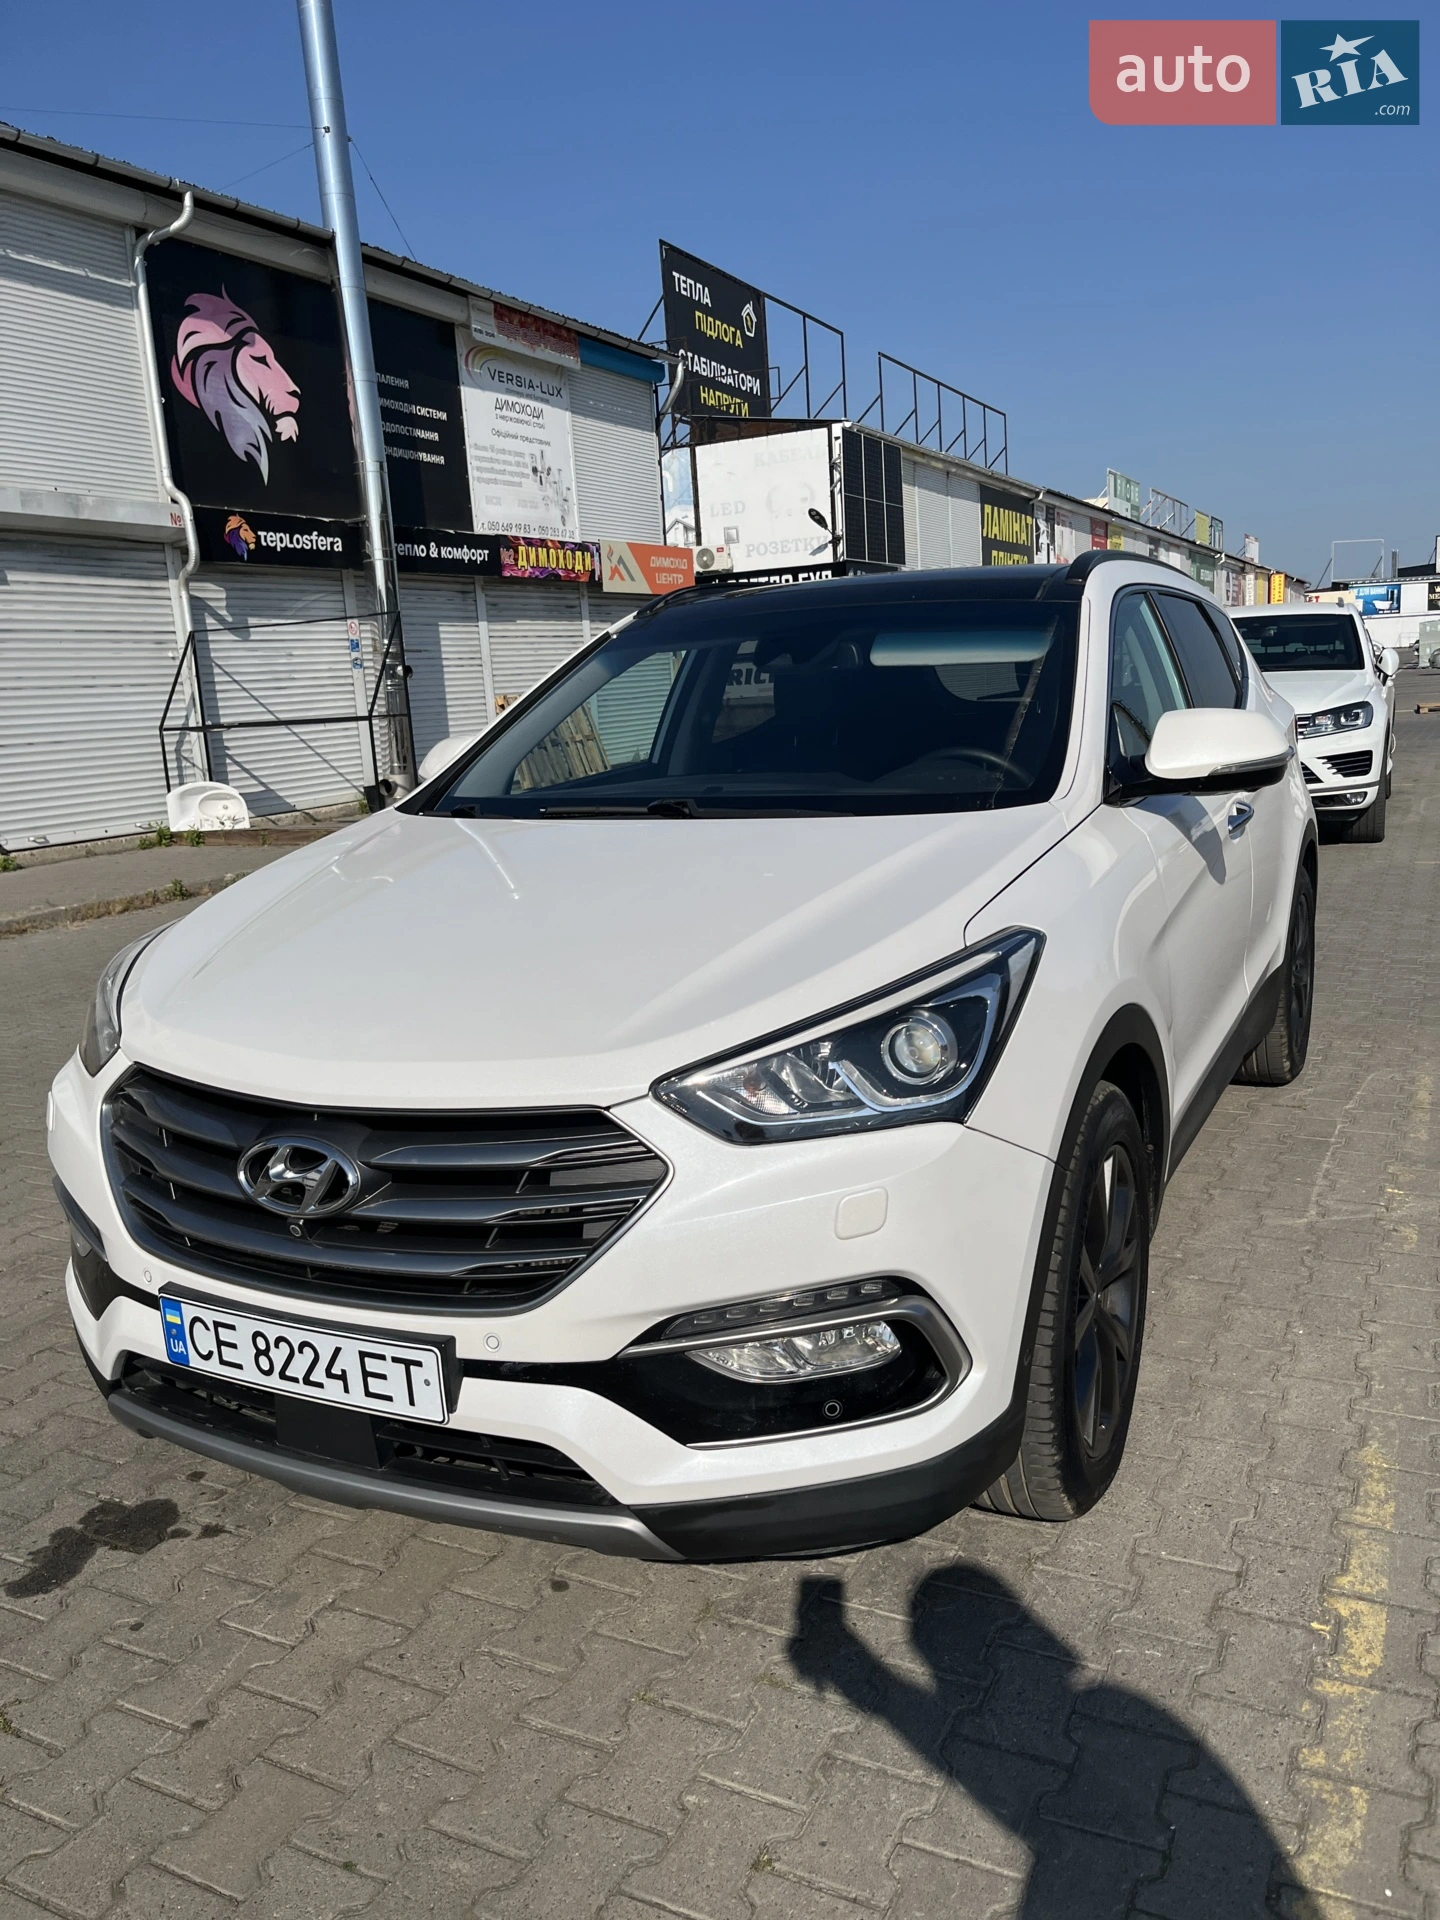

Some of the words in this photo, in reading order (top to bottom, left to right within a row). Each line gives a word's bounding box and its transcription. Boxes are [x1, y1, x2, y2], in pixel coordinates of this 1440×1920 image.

[672, 271, 712, 307] ТЕПЛА
[695, 311, 743, 348] ПІДЛОГА
[376, 372, 409, 389] ПАЛЕННЯ
[487, 366, 563, 398] VERSIA-LUX
[678, 349, 761, 396] СТАБІЛІЗАТОРИ
[379, 397, 416, 414] ИМОХОДНІ
[416, 406, 447, 421] СИСТЕМИ
[495, 397, 544, 420] ДИМОХОДИ
[700, 385, 749, 417] НАПРУГИ
[381, 421, 440, 441] ОДОПОСТАЧАННЯ
[384, 445, 445, 465] ОНДИЦІОНУВАННЯ
[711, 500, 745, 518] LED
[487, 521, 500, 532] 050
[501, 521, 513, 533] 649
[983, 504, 1032, 547] ЛАМІНАТ
[429, 542, 438, 558] &
[441, 544, 489, 564] комфорт
[745, 535, 829, 558] РОЗЕТКИ
[517, 545, 592, 574] ДИМОХОДИ
[650, 555, 687, 569] ДИМОХІД
[655, 573, 684, 584] ЦЕНТР
[170, 1338, 187, 1356] UA
[188, 1315, 244, 1371] CE
[251, 1330, 350, 1394] 8224
[358, 1349, 423, 1407] ET
